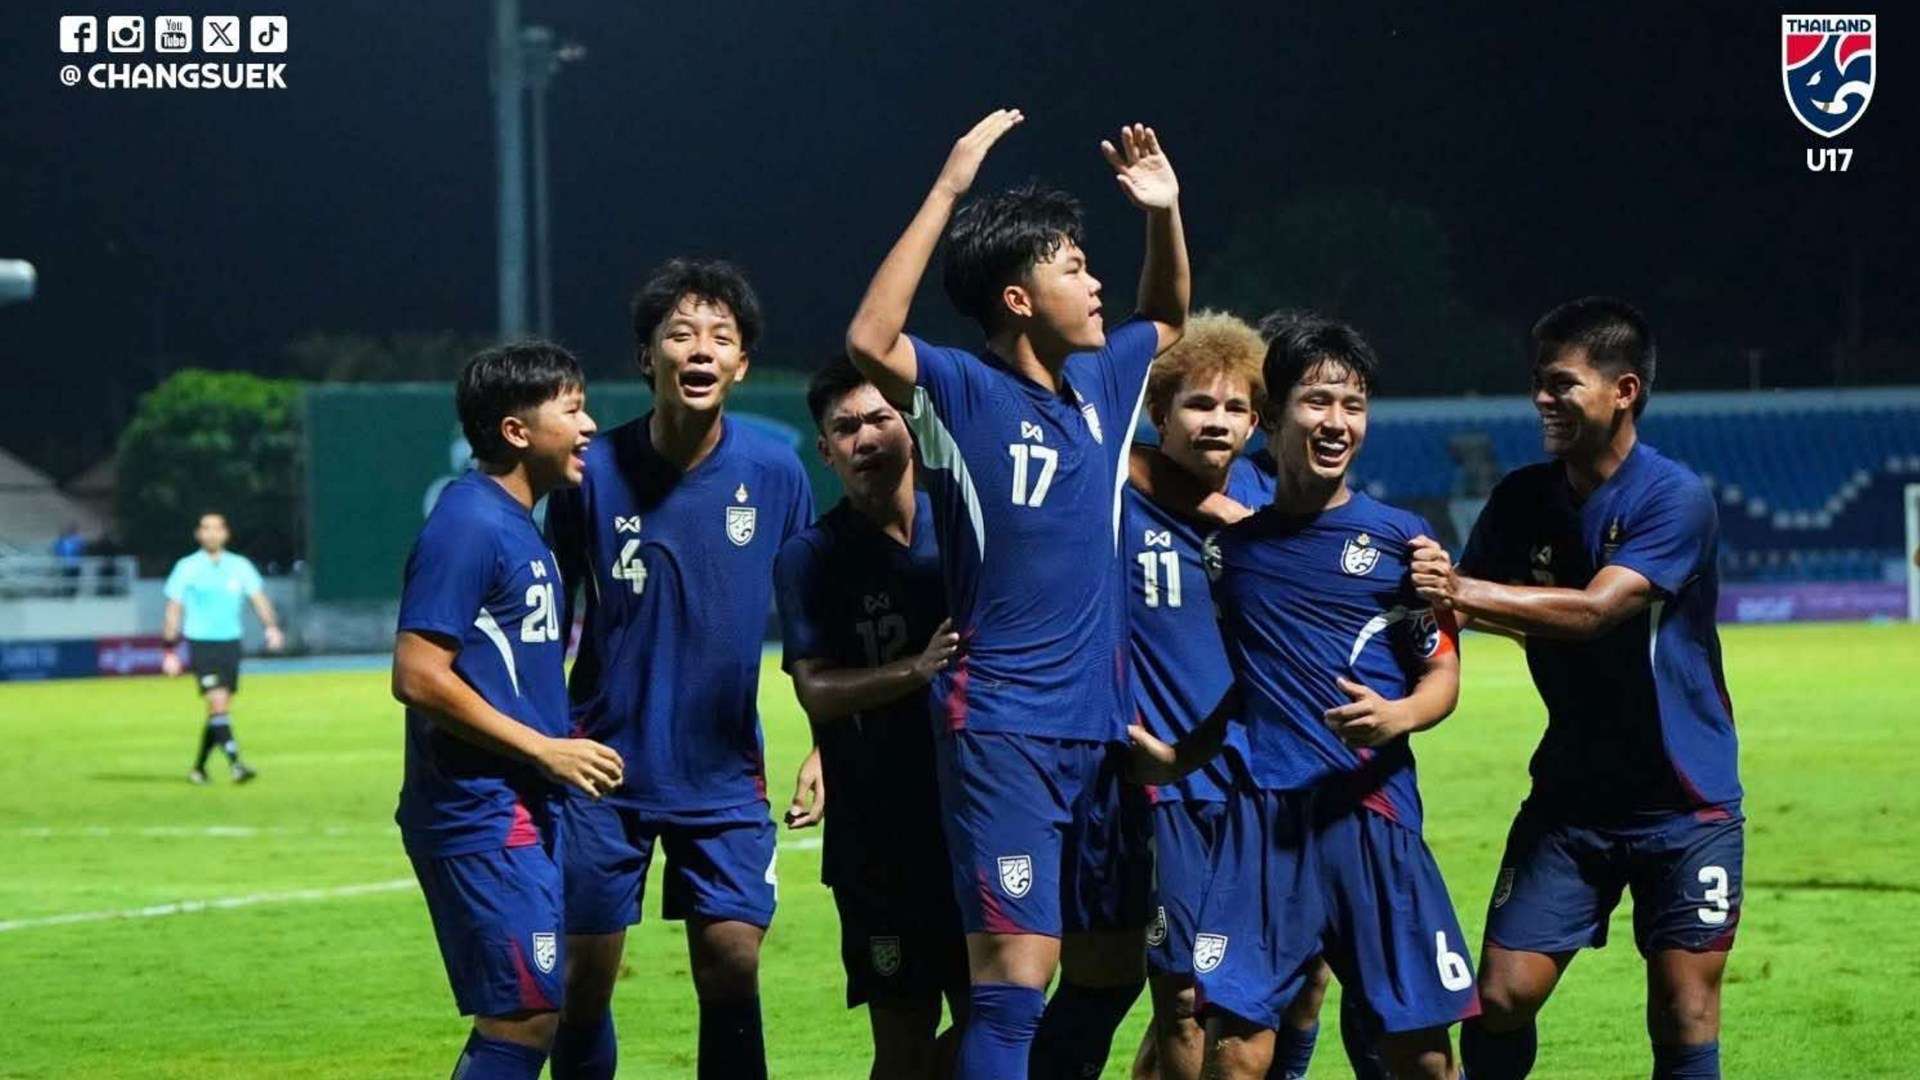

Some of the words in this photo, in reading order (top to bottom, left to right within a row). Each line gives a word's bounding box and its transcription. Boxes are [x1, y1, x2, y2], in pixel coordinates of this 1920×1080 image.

[1009, 443, 1058, 508] 17
[612, 538, 648, 595] 4
[1137, 550, 1182, 608] 11
[1697, 865, 1730, 925] 3
[1435, 930, 1473, 992] 6
